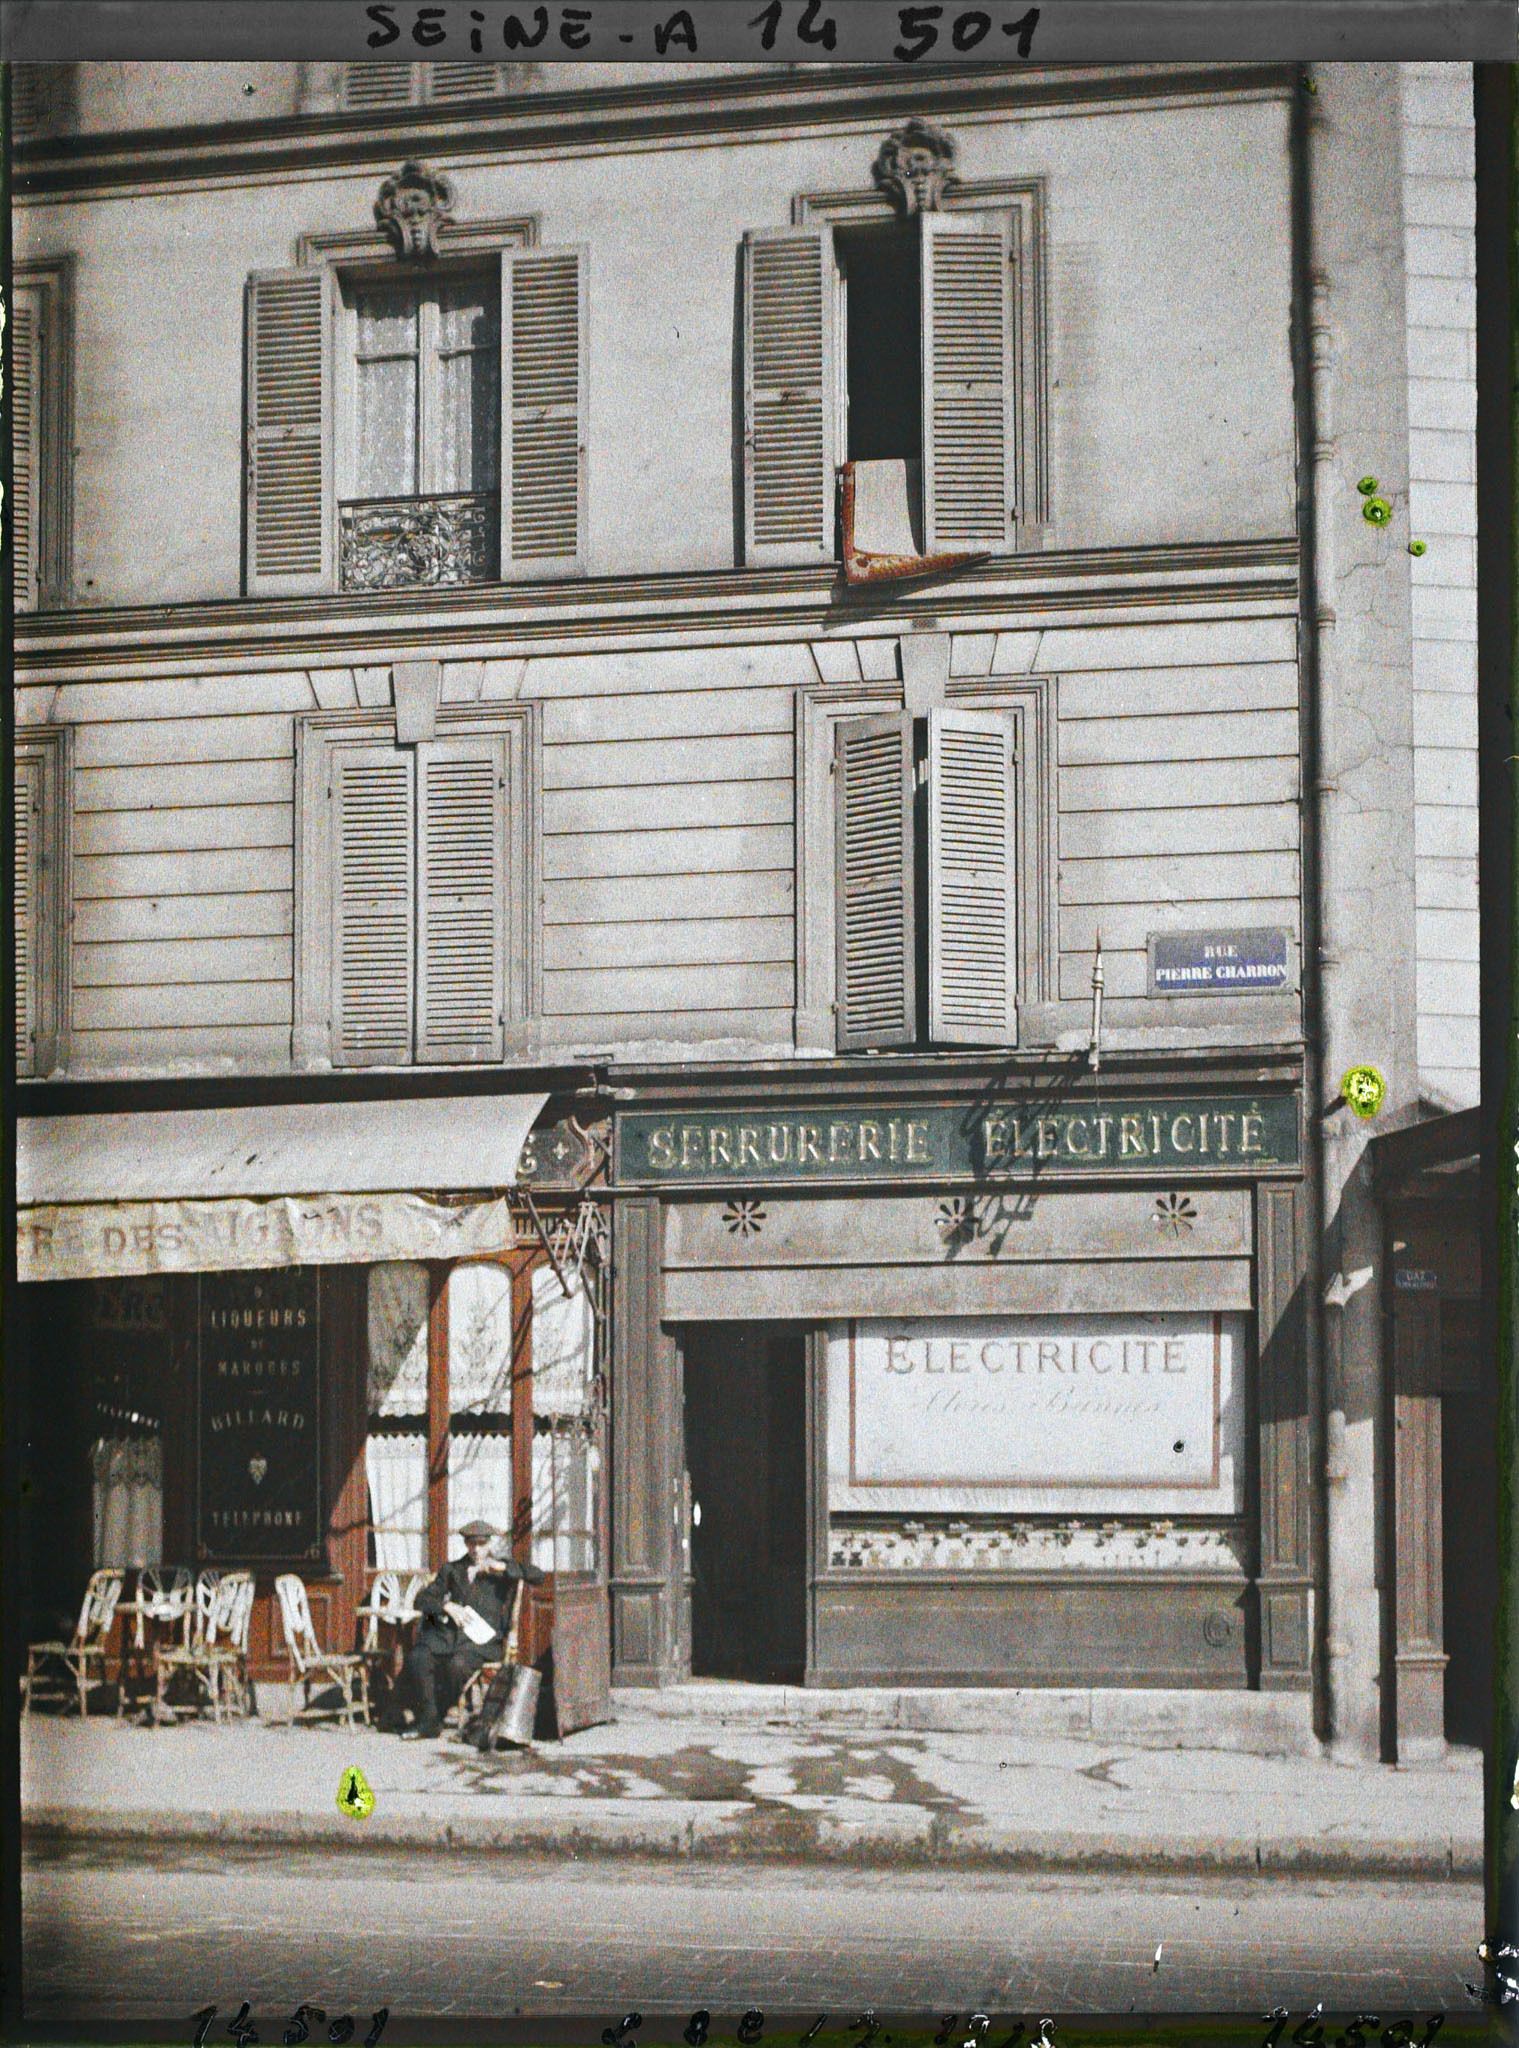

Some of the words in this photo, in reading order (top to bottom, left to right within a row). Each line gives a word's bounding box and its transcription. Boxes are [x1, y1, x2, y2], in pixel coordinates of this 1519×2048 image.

[1204, 945, 1238, 958] RUE
[1156, 966, 1213, 981] PIERRE
[1216, 963, 1288, 978] CHARRON
[649, 1120, 930, 1167] SERRURERIE
[211, 1309, 306, 1329] LIQUEURS
[218, 1361, 301, 1377] MARQUES
[211, 1410, 305, 1433] BILLARD
